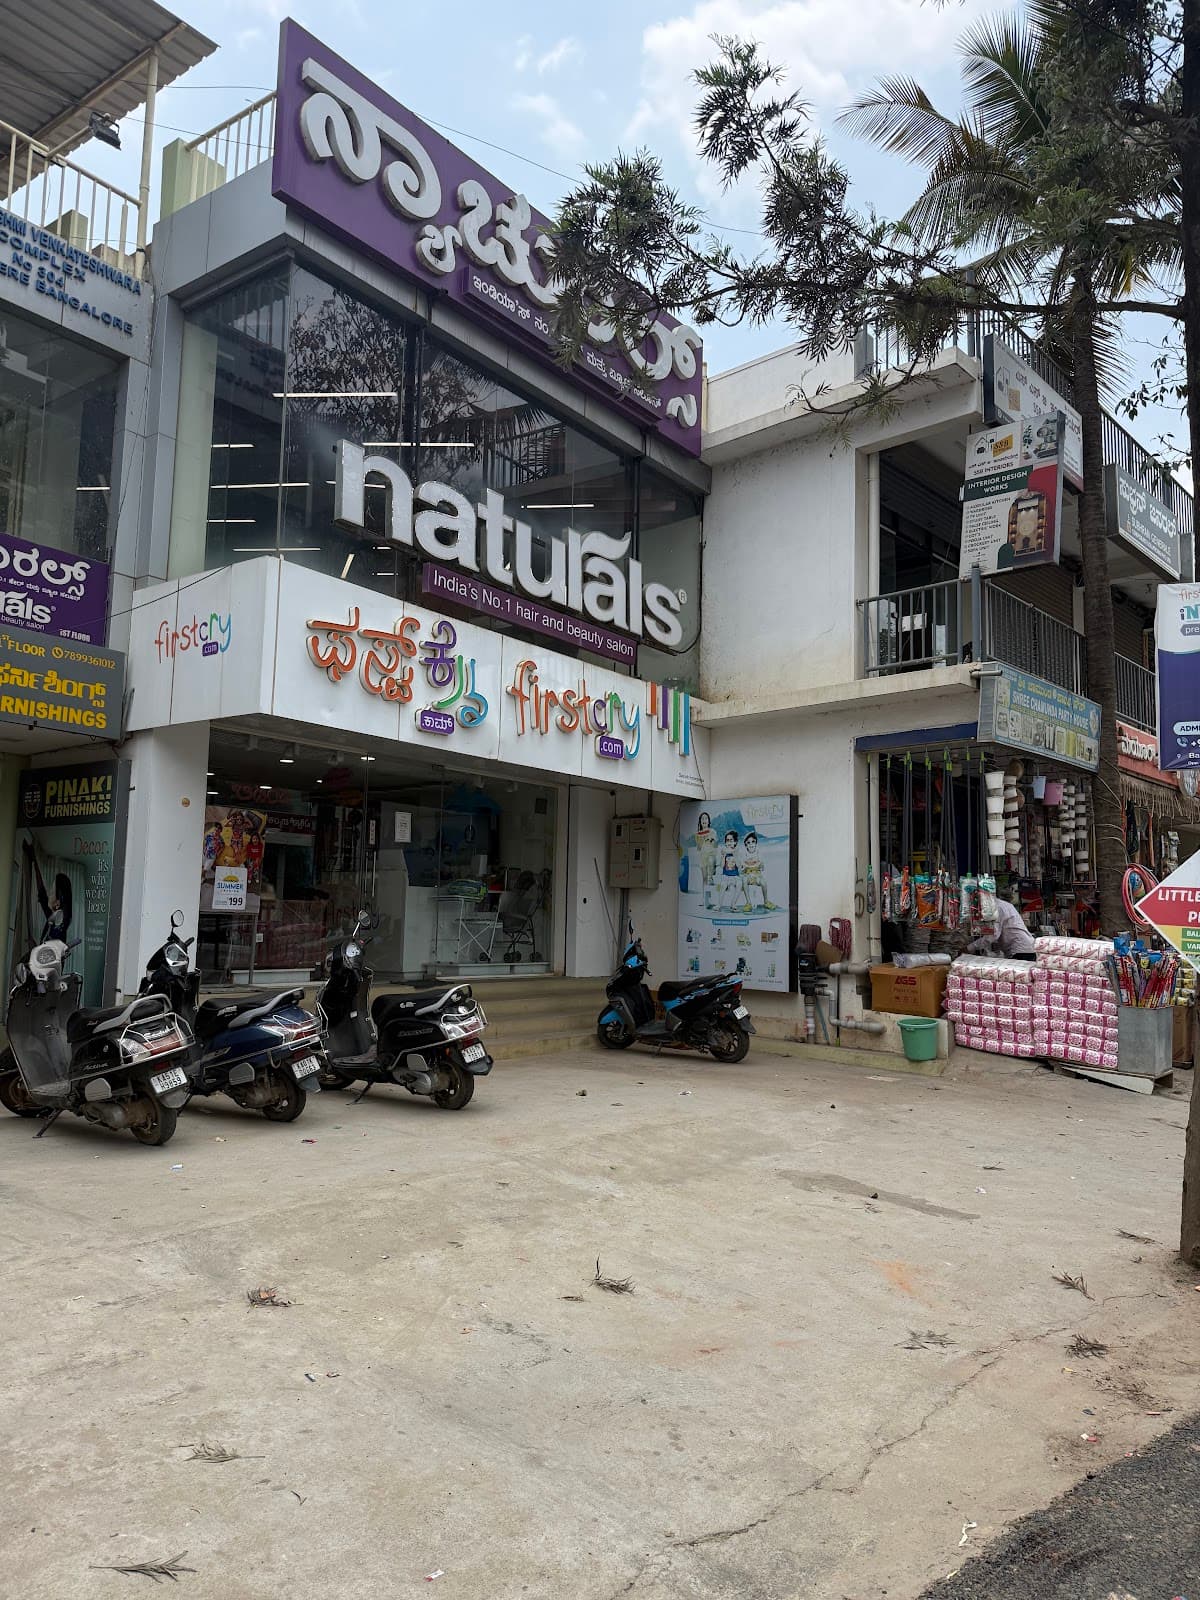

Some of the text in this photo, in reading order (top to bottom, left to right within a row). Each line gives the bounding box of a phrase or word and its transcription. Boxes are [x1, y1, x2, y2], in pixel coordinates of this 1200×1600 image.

[0, 231, 85, 283] COMPLEX
[31, 226, 141, 296] VENKATESHWARA
[12, 252, 65, 288] No 304
[36, 280, 133, 335] BANGALORE
[985, 461, 1014, 474] INTERIORS
[968, 470, 1027, 489] INTERIOR DESIGN
[984, 483, 1008, 493] WORKS
[334, 439, 683, 647] naturals
[433, 569, 634, 657] India's No.1 hair and beauty salon
[26, 621, 45, 630] salon
[71, 632, 91, 643] FLOOR
[154, 613, 231, 663] firstcry
[8, 640, 45, 658] FLOOR
[506, 660, 640, 760] firstcry
[45, 776, 113, 804] PINAKI
[44, 801, 111, 819] FURNISHINGS
[217, 882, 243, 890] SUMMER
[88, 900, 106, 913] here
[229, 897, 243, 906] 199
[894, 975, 917, 986] AGS
